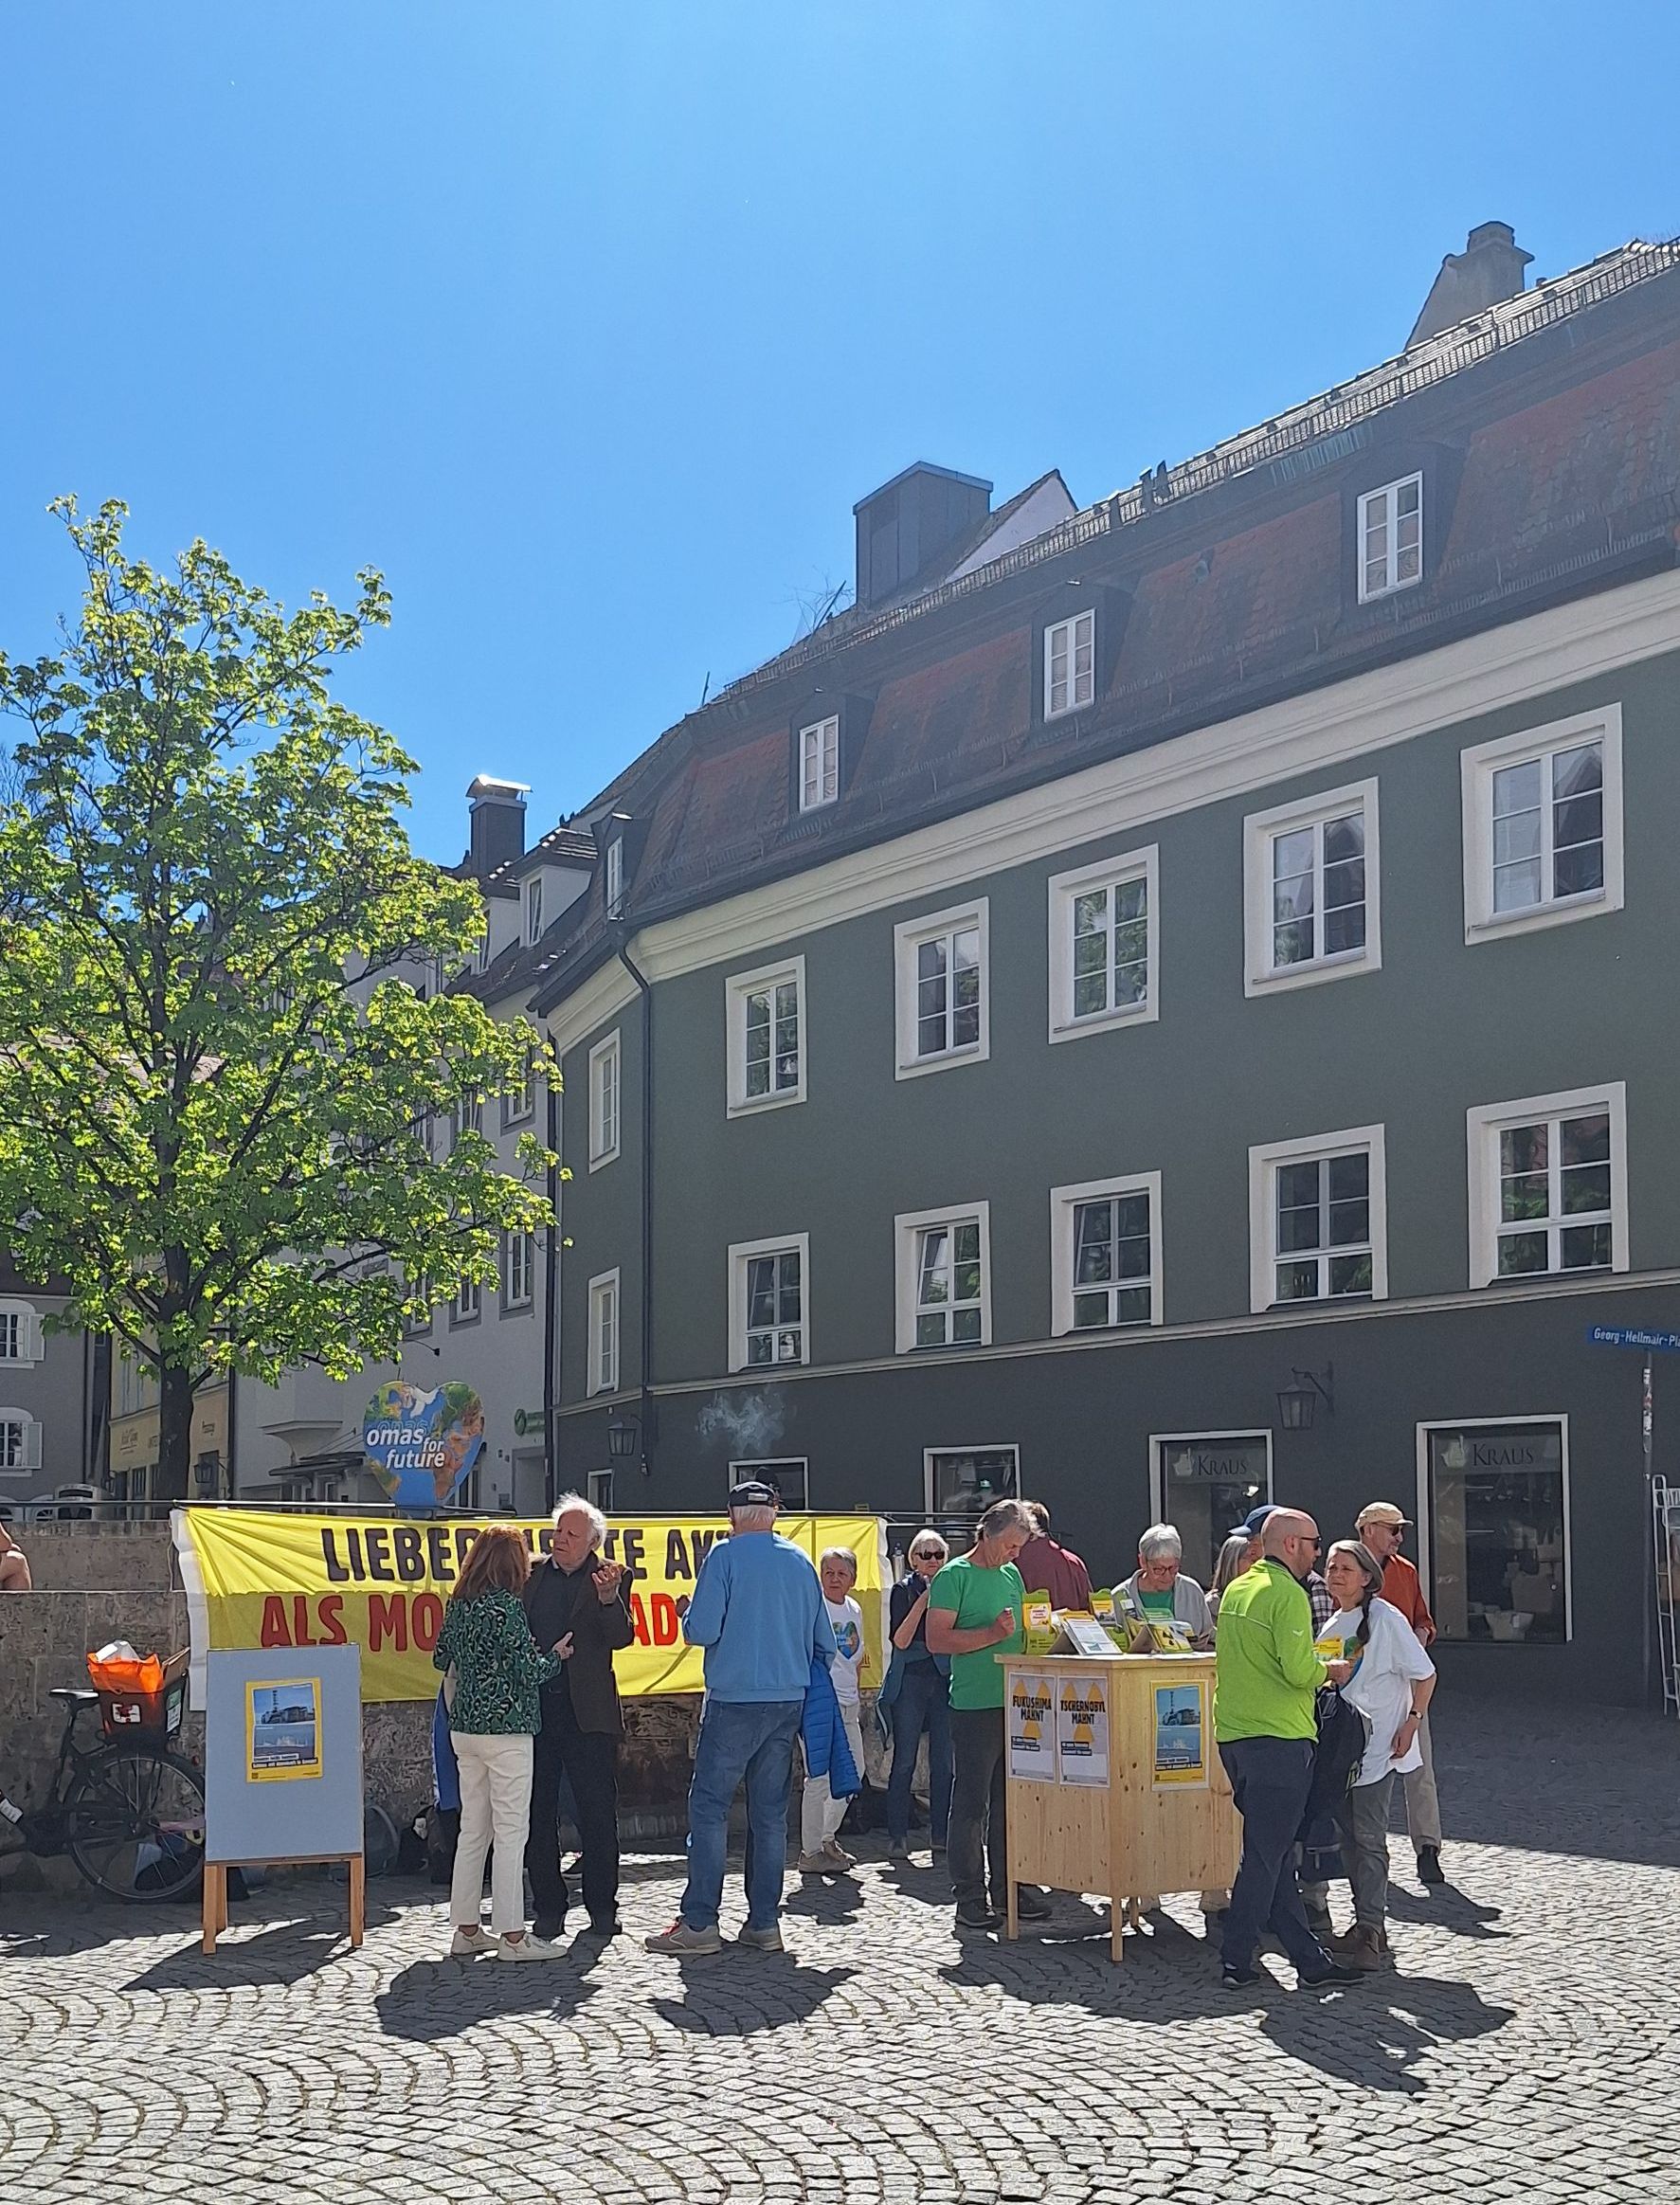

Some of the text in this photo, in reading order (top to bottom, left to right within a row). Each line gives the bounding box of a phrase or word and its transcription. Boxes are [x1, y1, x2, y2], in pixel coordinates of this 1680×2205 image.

[367, 1429, 425, 1446] omas
[423, 1437, 444, 1453] for
[386, 1449, 445, 1469] future
[261, 1596, 347, 1647] ALS
